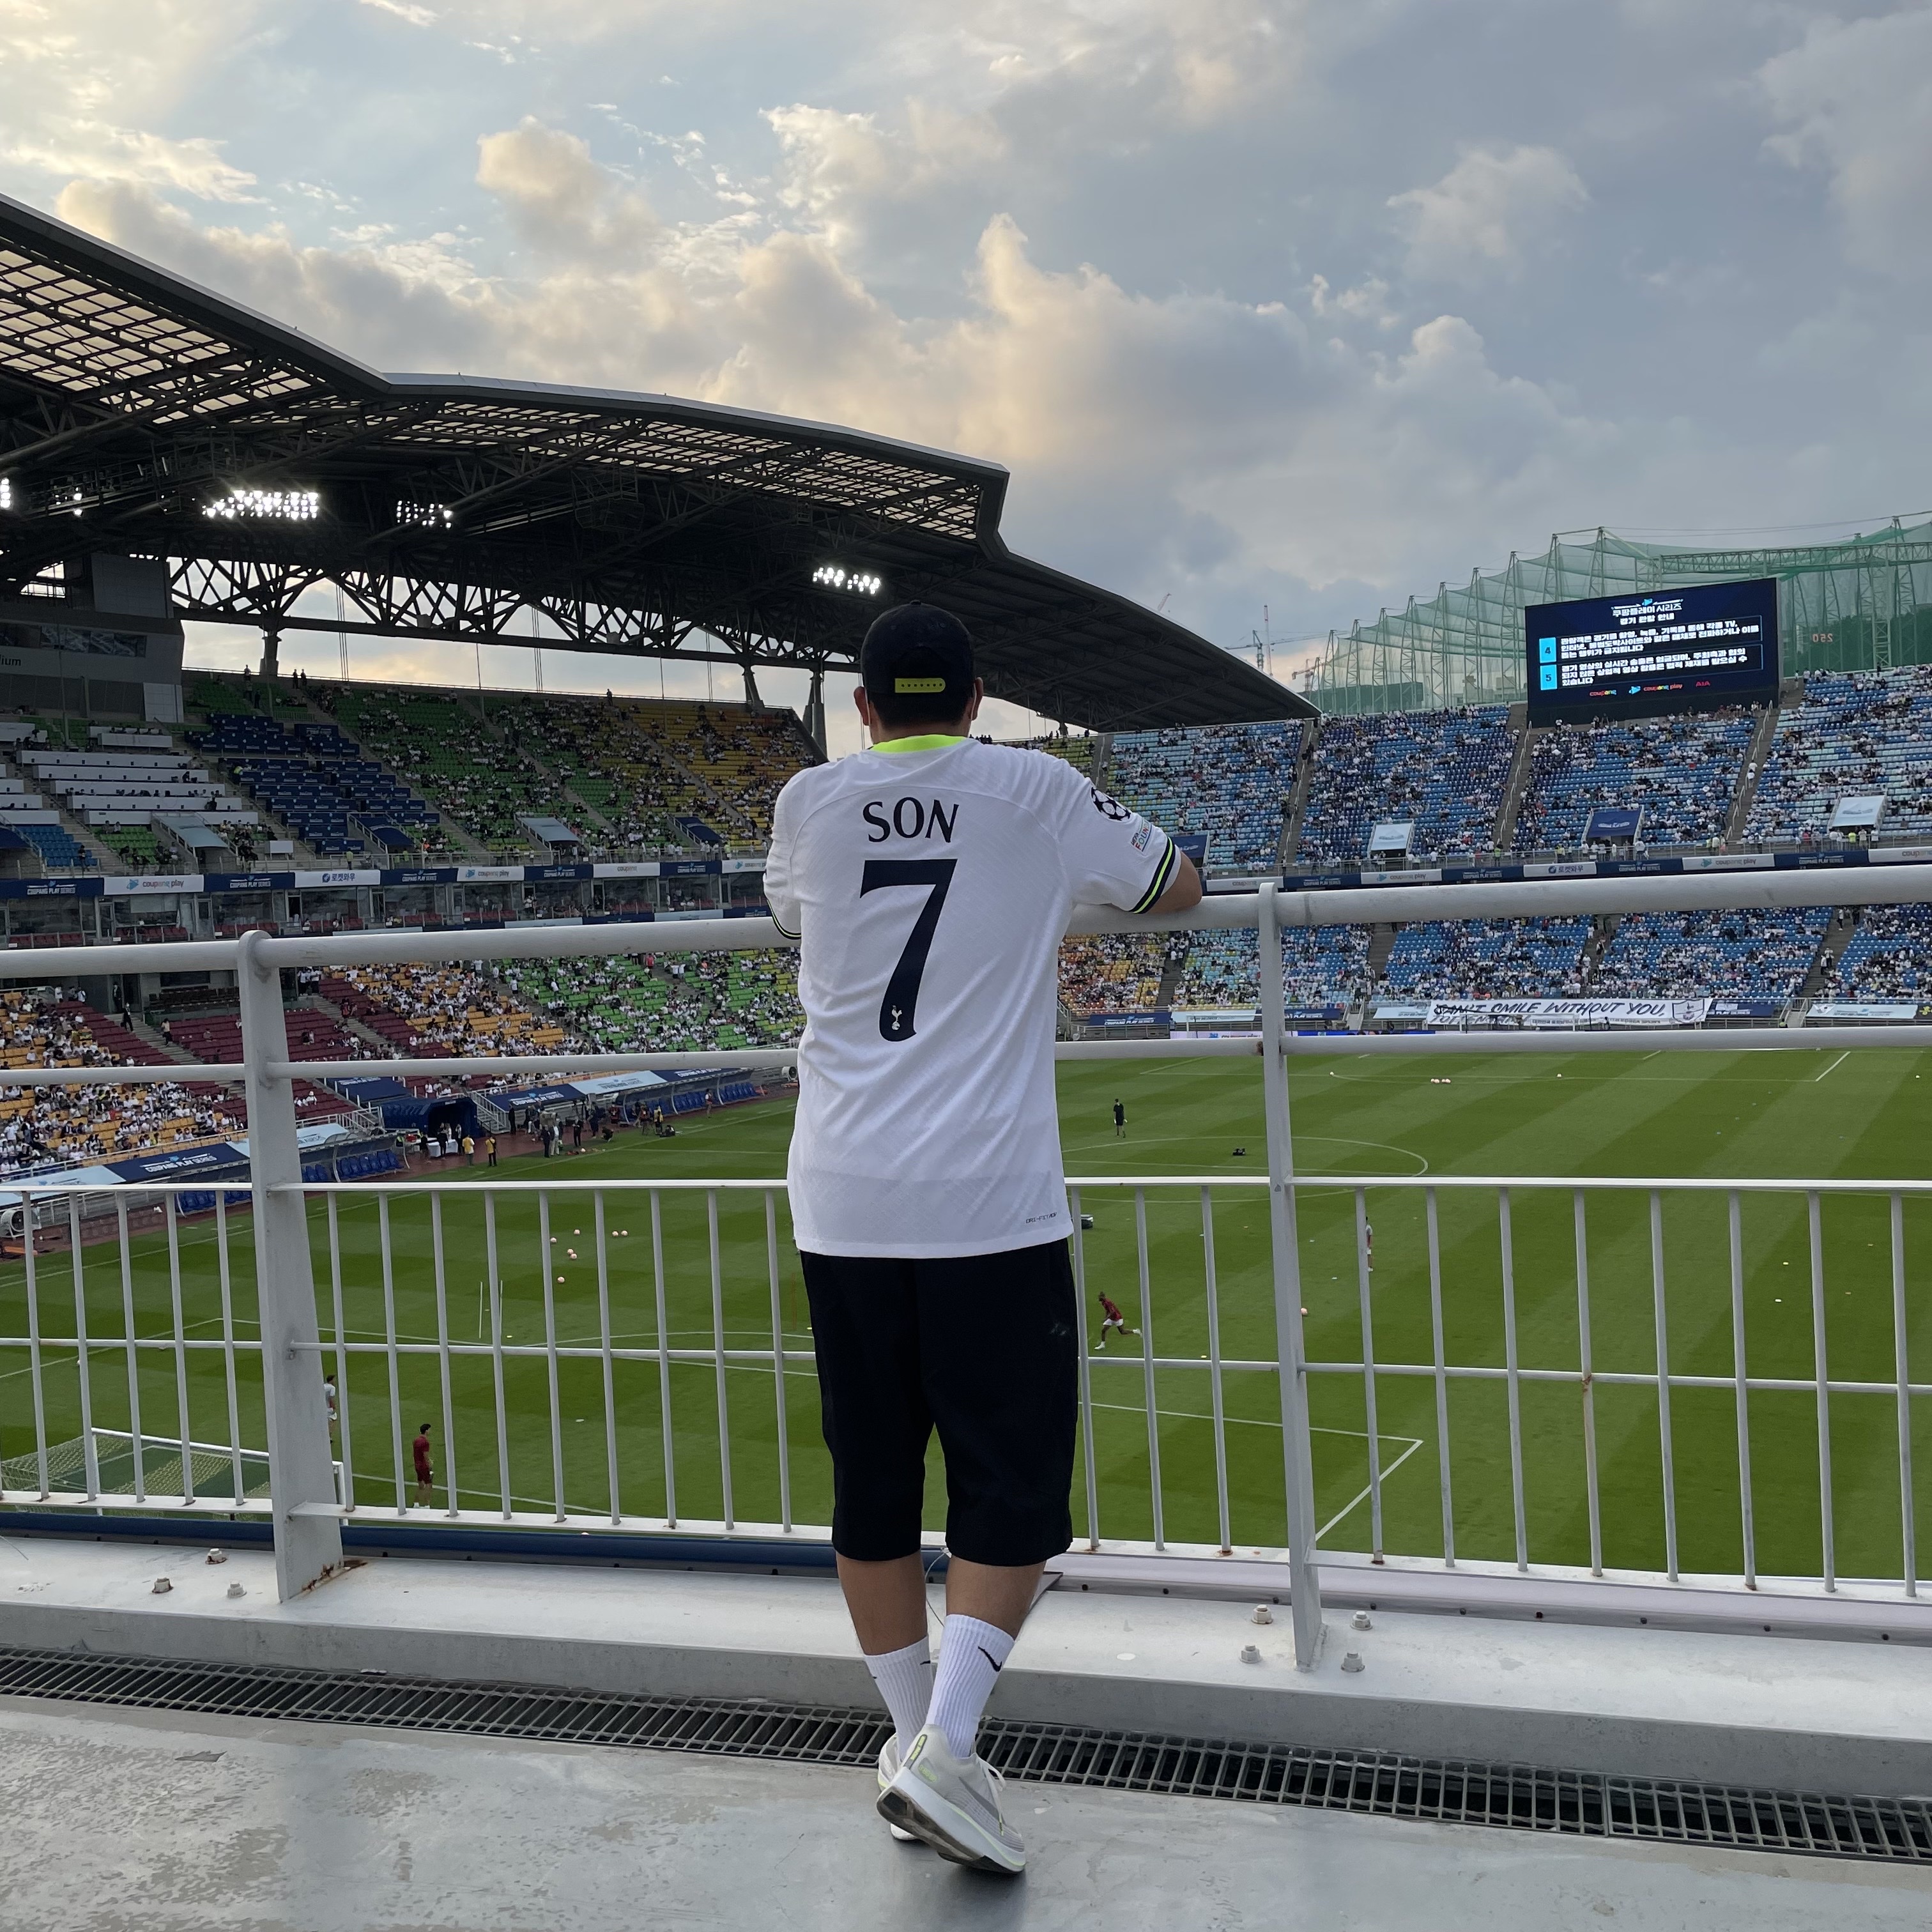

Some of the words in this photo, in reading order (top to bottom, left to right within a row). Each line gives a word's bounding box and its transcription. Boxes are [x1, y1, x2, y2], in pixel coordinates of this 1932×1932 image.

[1612, 606, 1655, 617] 쿠팡플레이
[1656, 602, 1682, 612] 시리즈
[861, 797, 959, 843] SON
[1558, 864, 1584, 873] 로켓와우
[142, 880, 170, 889] coupang
[171, 879, 184, 888] play
[331, 873, 355, 882] 로켓와우
[859, 858, 958, 1042] 7
[1544, 1002, 1625, 1015] WITHOUT
